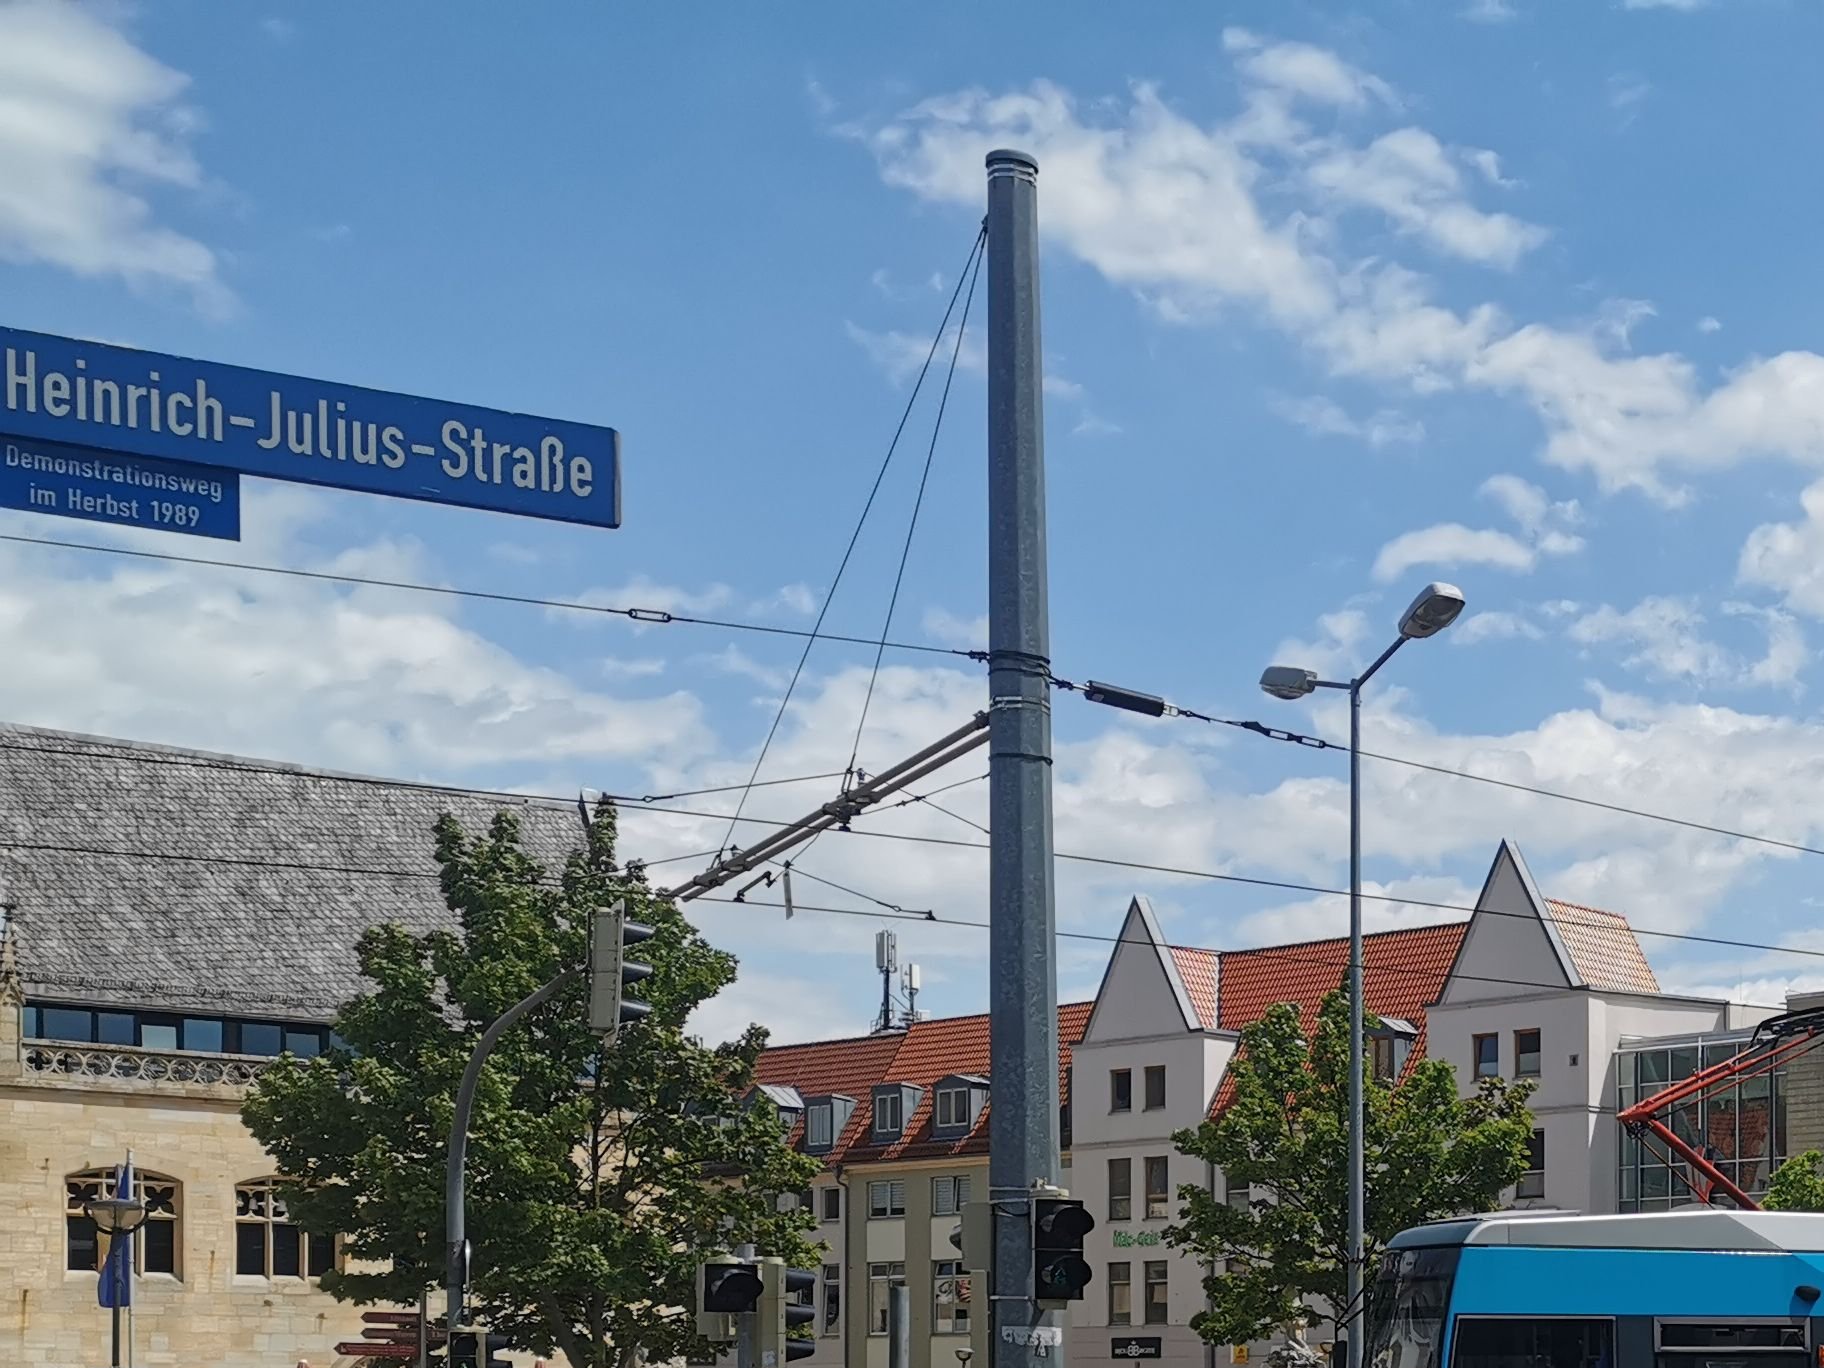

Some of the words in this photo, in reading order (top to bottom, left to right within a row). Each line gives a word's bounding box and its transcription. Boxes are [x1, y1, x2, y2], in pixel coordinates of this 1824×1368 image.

[6, 347, 593, 498] Heinrich-Julius-Straße
[6, 445, 223, 503] Demonstrationsweg
[29, 482, 56, 507] im
[68, 487, 139, 519] Herbst
[150, 500, 200, 528] 1989
